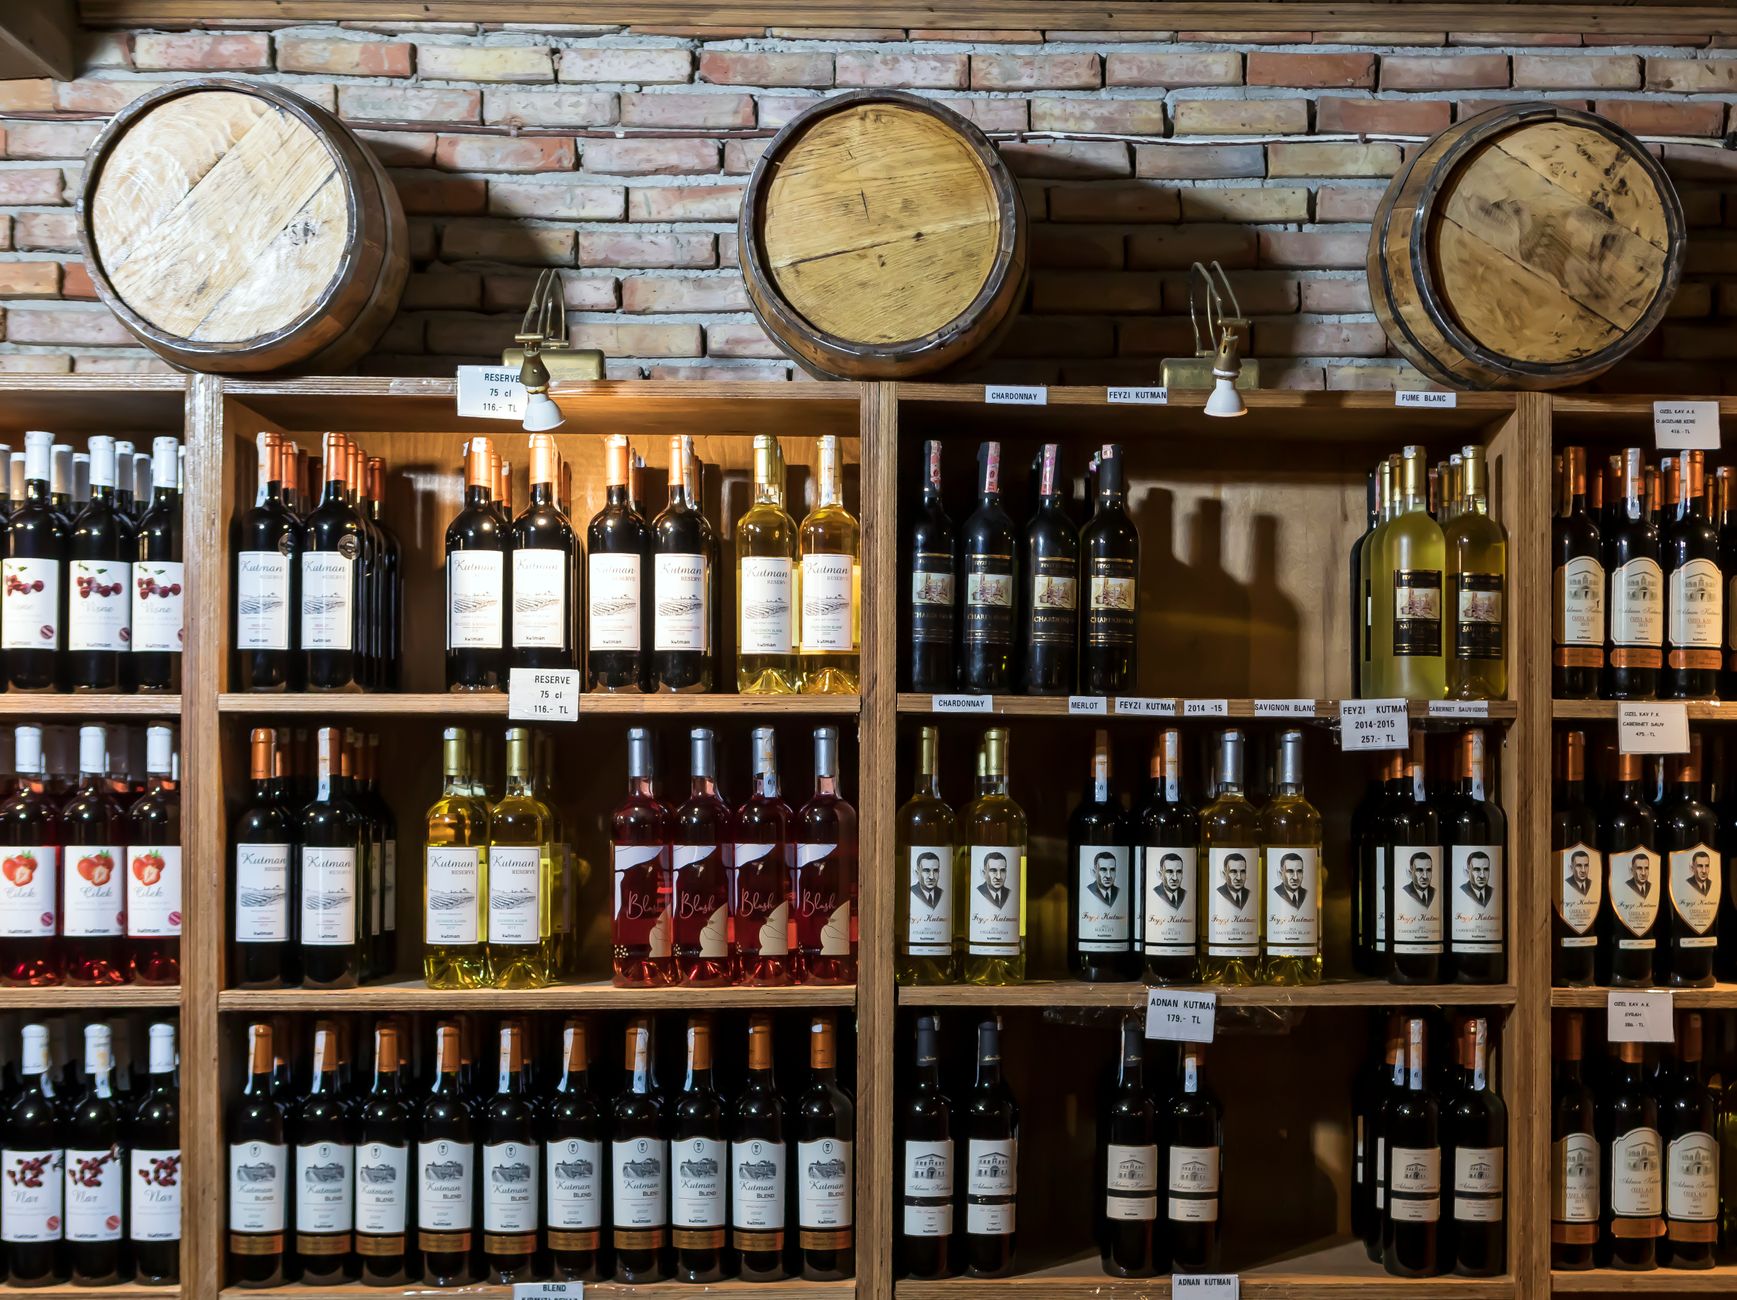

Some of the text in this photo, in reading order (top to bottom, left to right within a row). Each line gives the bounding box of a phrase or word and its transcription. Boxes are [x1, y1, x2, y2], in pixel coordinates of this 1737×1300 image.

[483, 372, 520, 383] RESERVE
[489, 388, 499, 397] 75
[991, 392, 1038, 401] CHARDONNAY
[1109, 390, 1167, 399] FEYZI KUTMAN
[1401, 394, 1447, 402] FUME BLANC
[509, 403, 517, 413] TL
[240, 560, 284, 572] Kutman
[304, 560, 346, 572] Kutman
[661, 562, 703, 574] Kutman
[805, 561, 849, 575] Kutman
[745, 566, 789, 579] Kutman
[534, 675, 571, 684] RESERVE
[540, 690, 549, 698] 75
[938, 699, 985, 708] CHARDONNAY
[1071, 701, 1098, 710] MERLOT
[1119, 701, 1176, 711] FEYZI KUTMAN
[1187, 704, 1205, 712] 2014
[1254, 703, 1290, 712] SAVIGNON
[1343, 703, 1408, 715] FEYZI KUTMAN
[1429, 705, 1455, 713] CABERNET
[533, 705, 568, 714] 116.- TL
[1356, 719, 1396, 729] 2014-2015
[1362, 733, 1396, 744] 257.- TL
[240, 852, 286, 865] Kutman
[306, 855, 352, 868] Kutman
[430, 855, 473, 868] Kutman
[491, 855, 534, 868] Kutman
[679, 889, 716, 920] Blush
[739, 887, 775, 918] Blush
[801, 887, 837, 918] Blush
[1151, 998, 1216, 1010] ADNAN KUTMAN
[1167, 1014, 1201, 1024] 179.- TL
[425, 1182, 461, 1192] Kutman
[491, 1183, 529, 1194] Kutman
[555, 1180, 592, 1191] Kutman
[623, 1179, 660, 1190] Kutman
[680, 1179, 716, 1189] Kutman
[739, 1180, 775, 1191] Kutman
[809, 1180, 845, 1191] Kutman
[11, 1189, 40, 1204] Nar
[72, 1189, 99, 1204] Nar
[143, 1189, 174, 1203] Nar
[1178, 1278, 1231, 1286] ADNAN KUTMAN
[542, 1284, 567, 1292] BLEND
